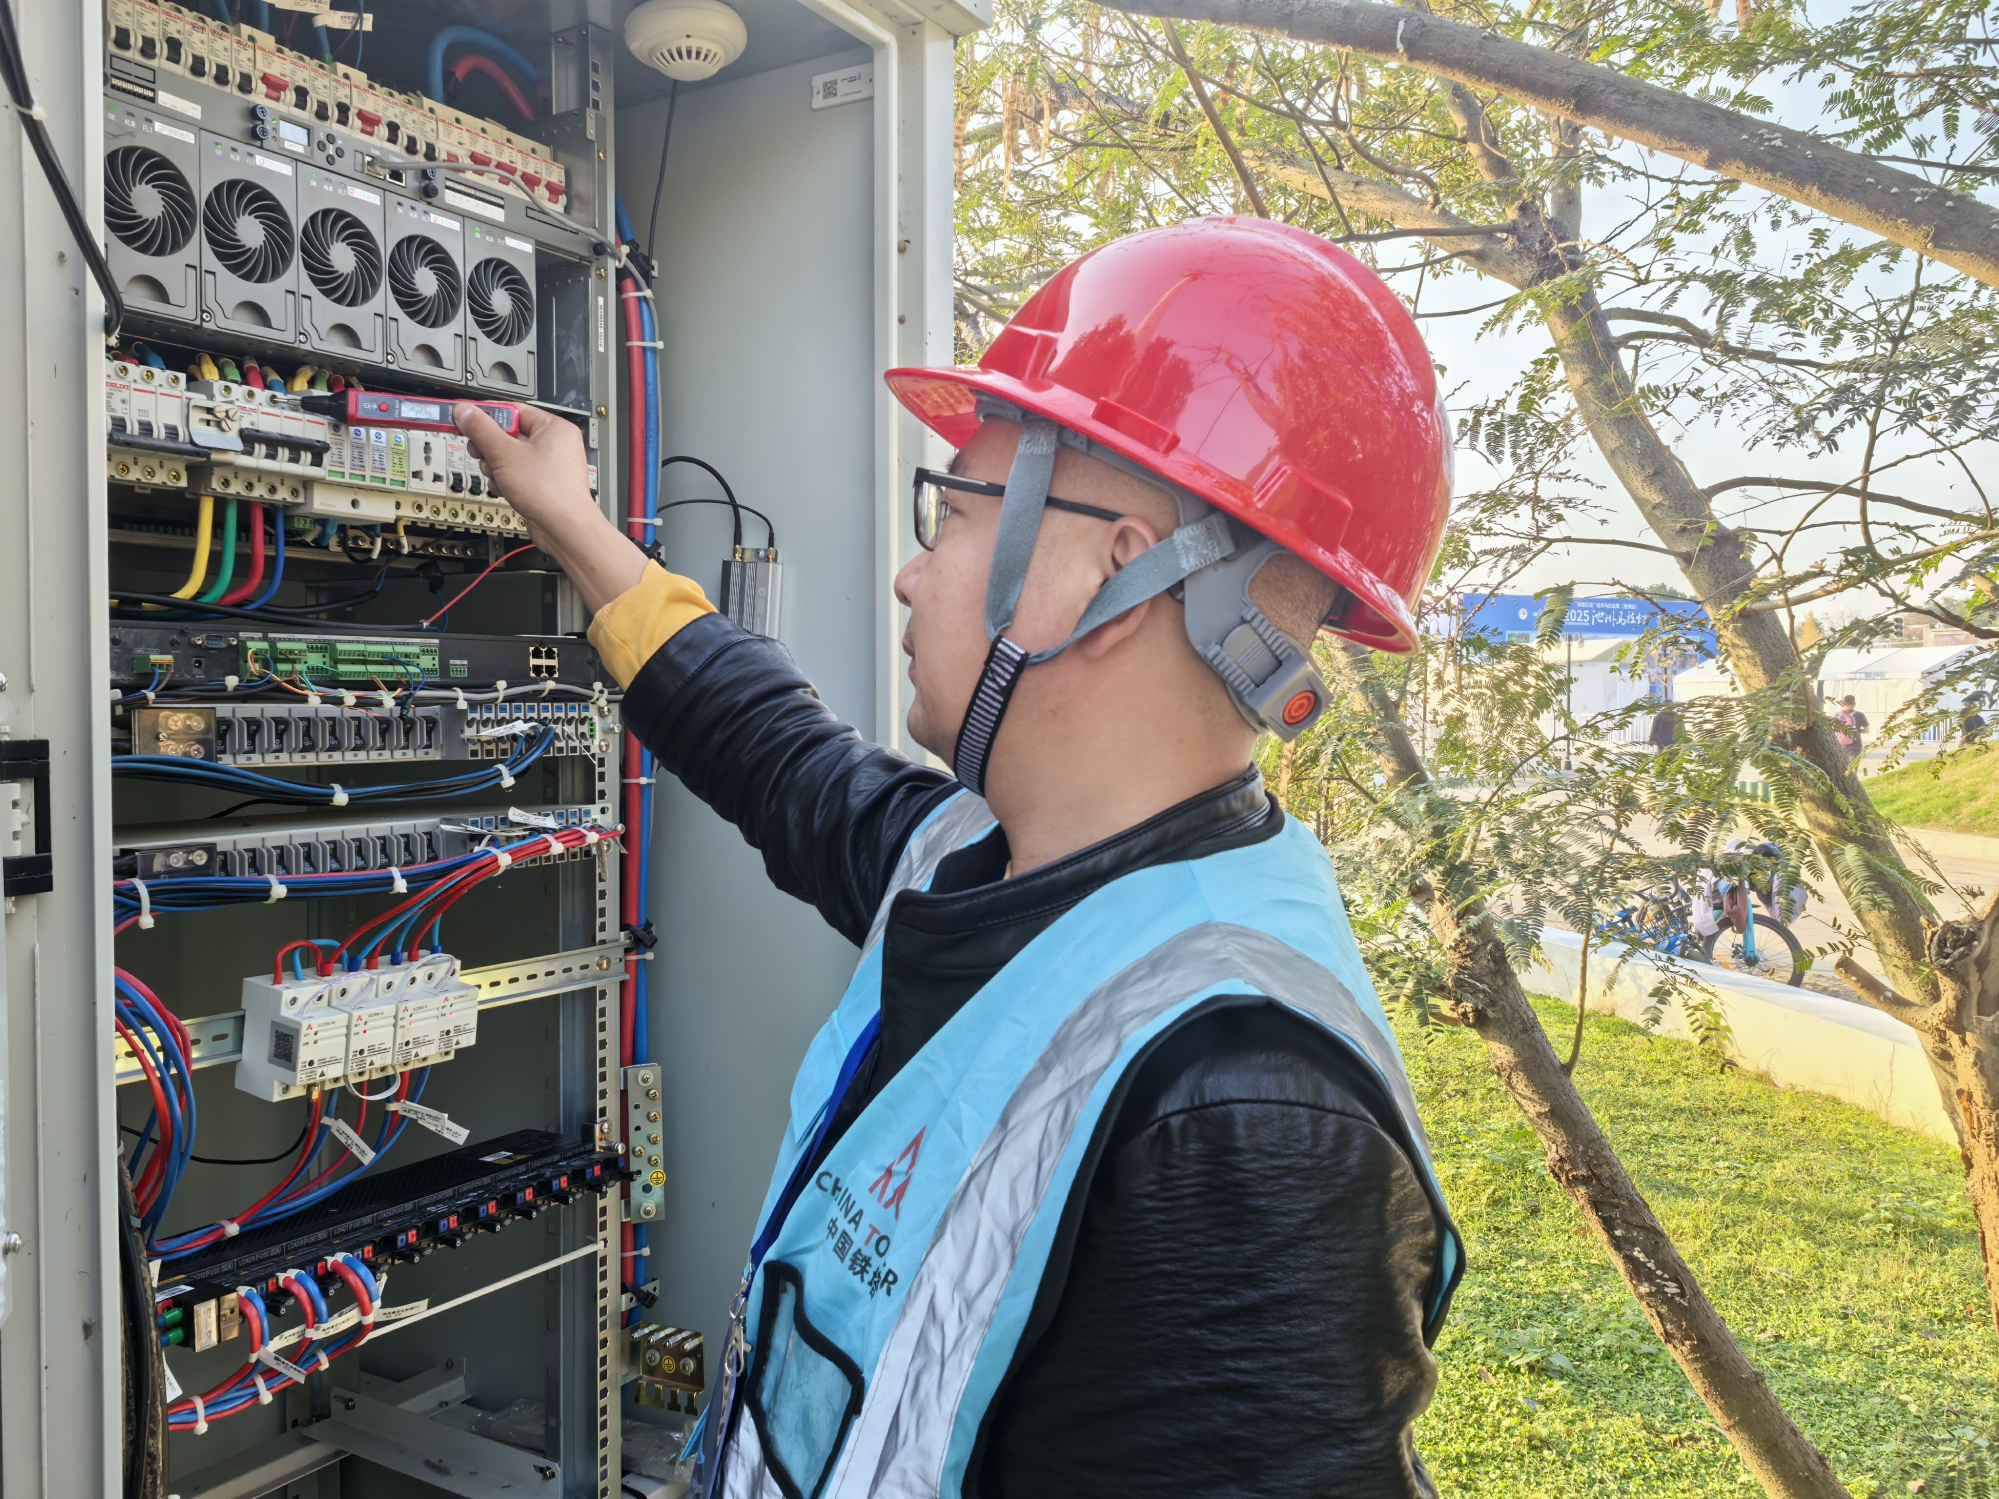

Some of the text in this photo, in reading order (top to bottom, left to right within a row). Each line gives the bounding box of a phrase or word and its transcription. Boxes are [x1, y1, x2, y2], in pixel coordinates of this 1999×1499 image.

[1564, 610, 1589, 622] 2025
[815, 1170, 899, 1296] CHINA TOR
[826, 1217, 883, 1300] 中国铁塔
